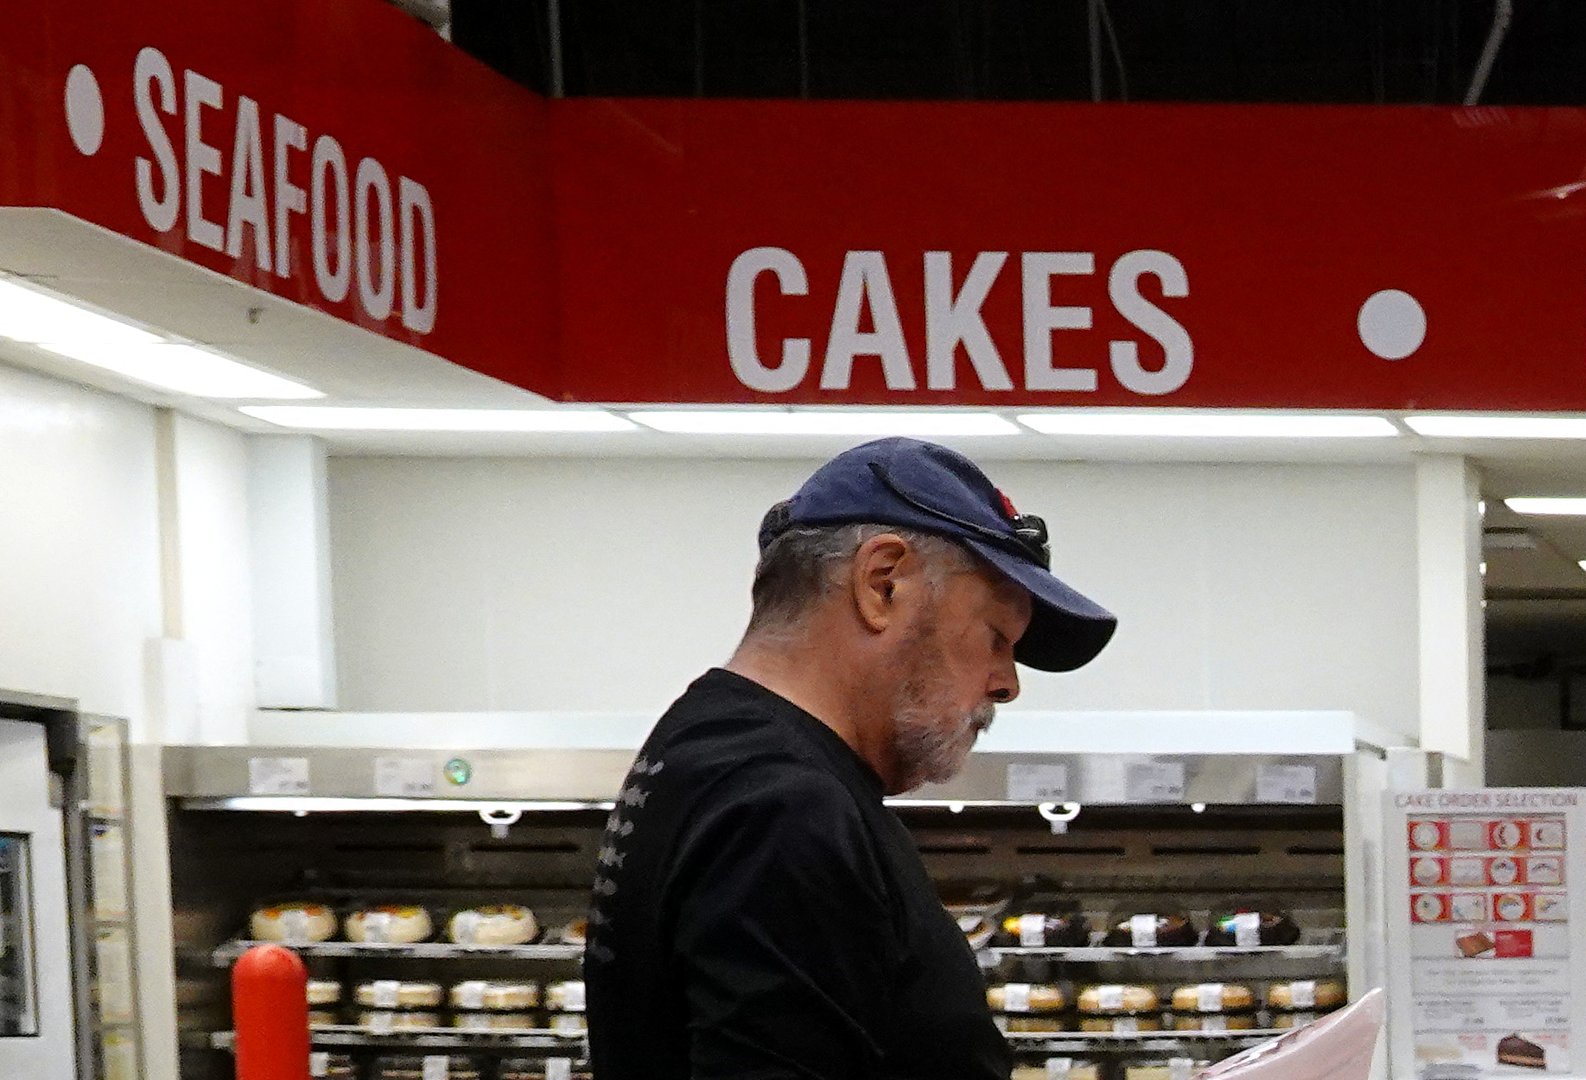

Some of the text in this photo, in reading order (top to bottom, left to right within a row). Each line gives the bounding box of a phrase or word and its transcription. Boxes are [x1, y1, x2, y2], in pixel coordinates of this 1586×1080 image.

[133, 46, 438, 335] SEAFOOD
[725, 246, 1195, 395] CAKES
[1395, 793, 1578, 808] CAKE ORDER SELECTION
